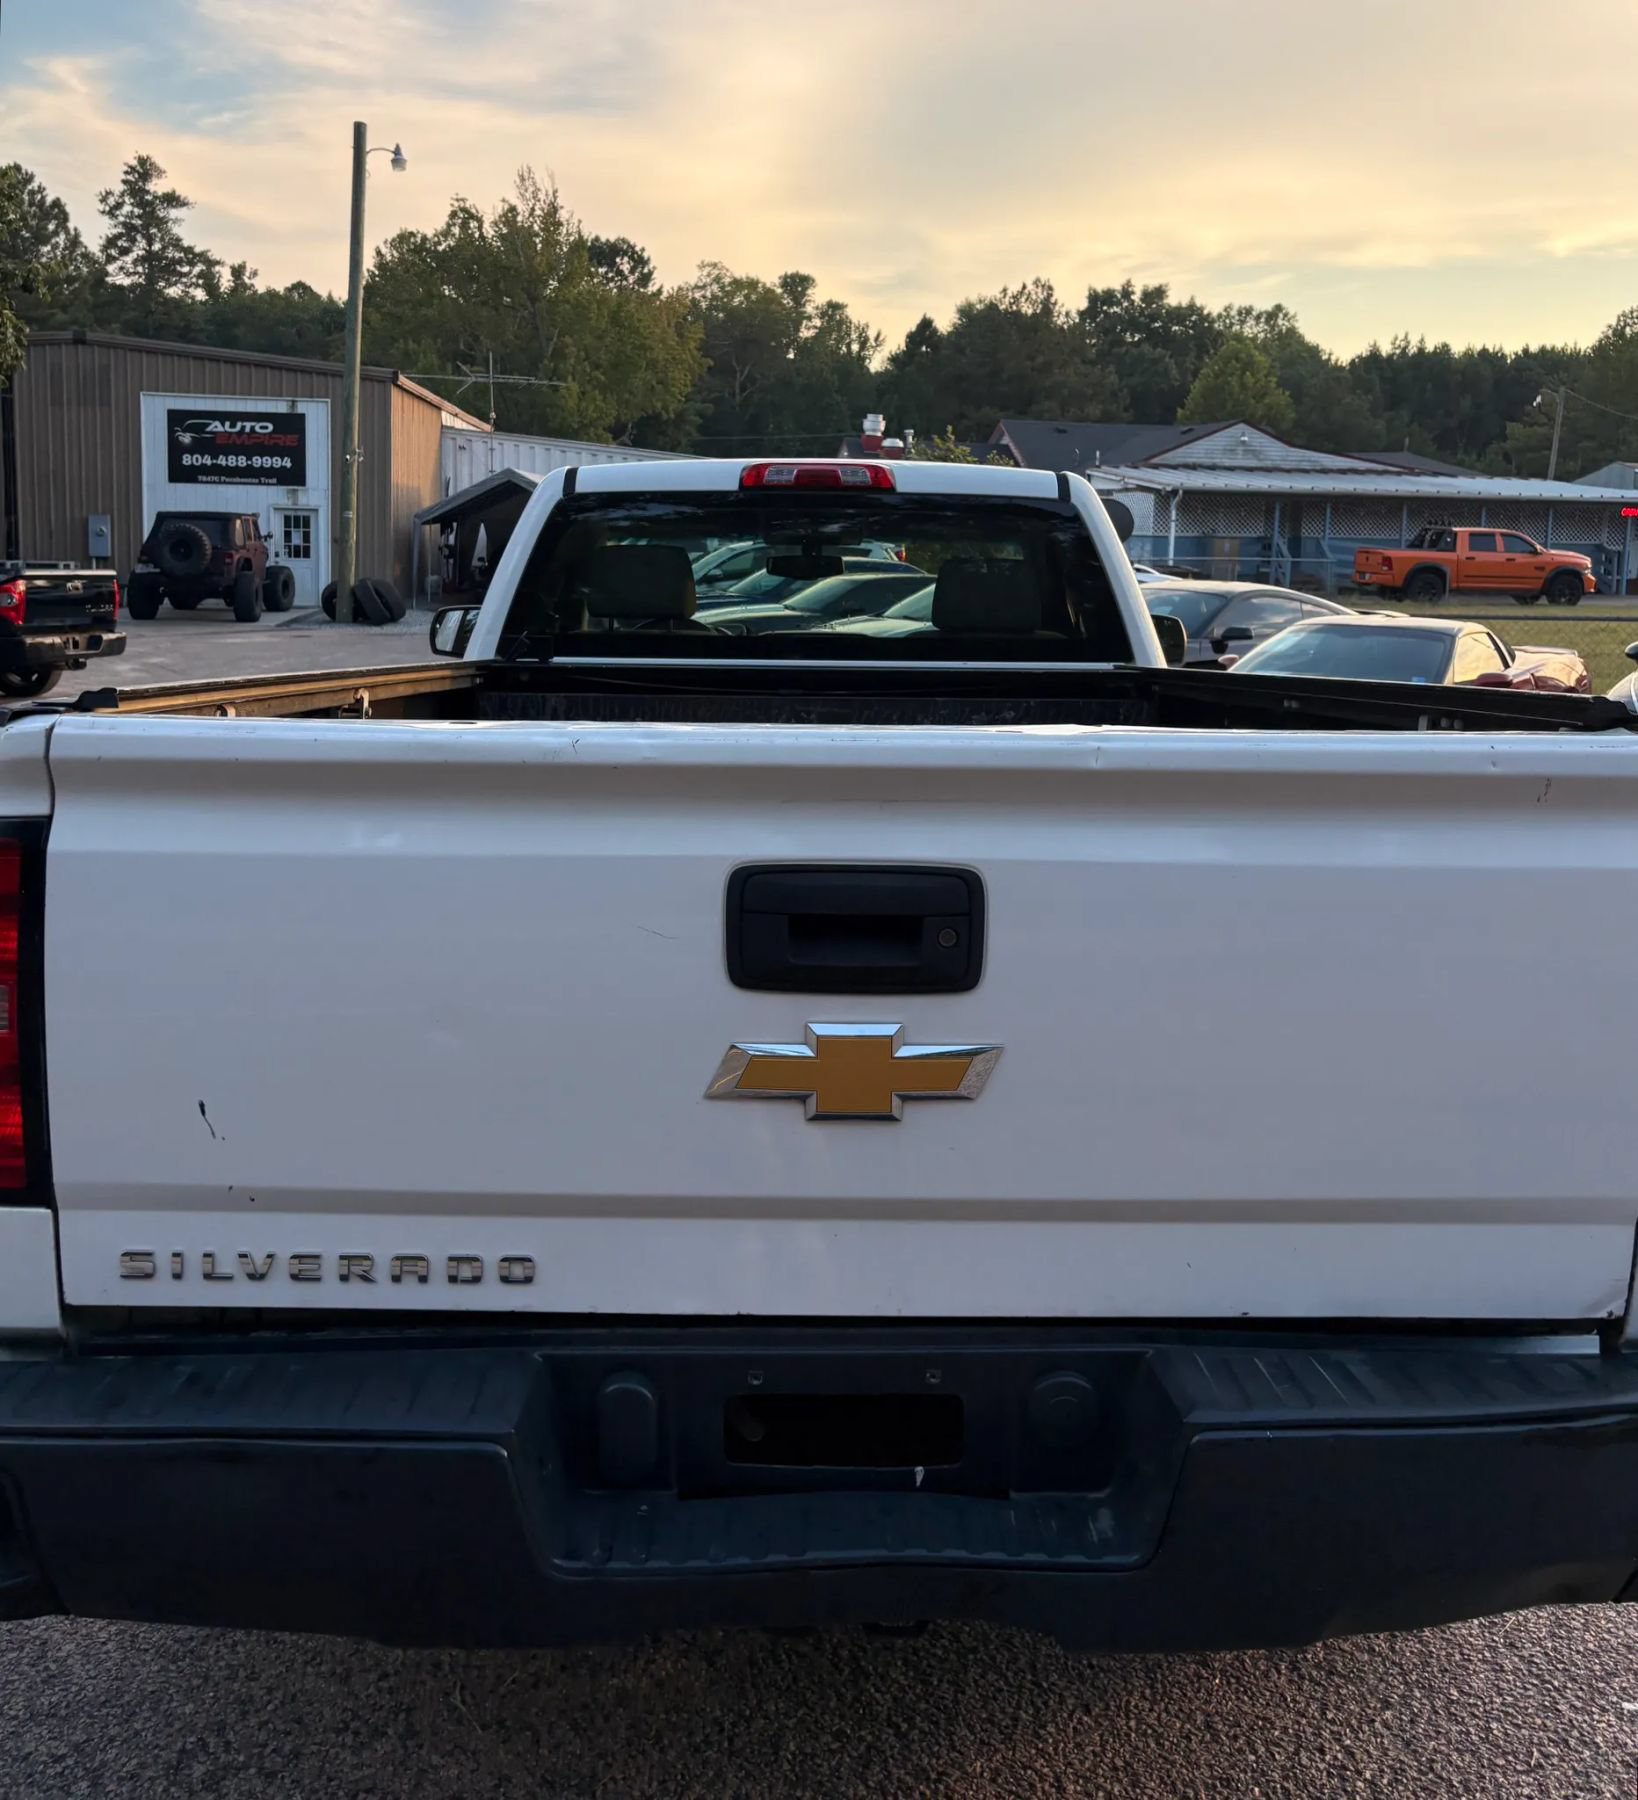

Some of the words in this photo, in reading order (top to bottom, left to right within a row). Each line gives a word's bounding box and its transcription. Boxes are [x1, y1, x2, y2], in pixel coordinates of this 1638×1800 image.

[206, 420, 273, 432] AUTO
[216, 434, 299, 446] EMPIRE
[182, 454, 292, 469] 804-488-9994
[119, 1249, 537, 1285] SILVERADO
